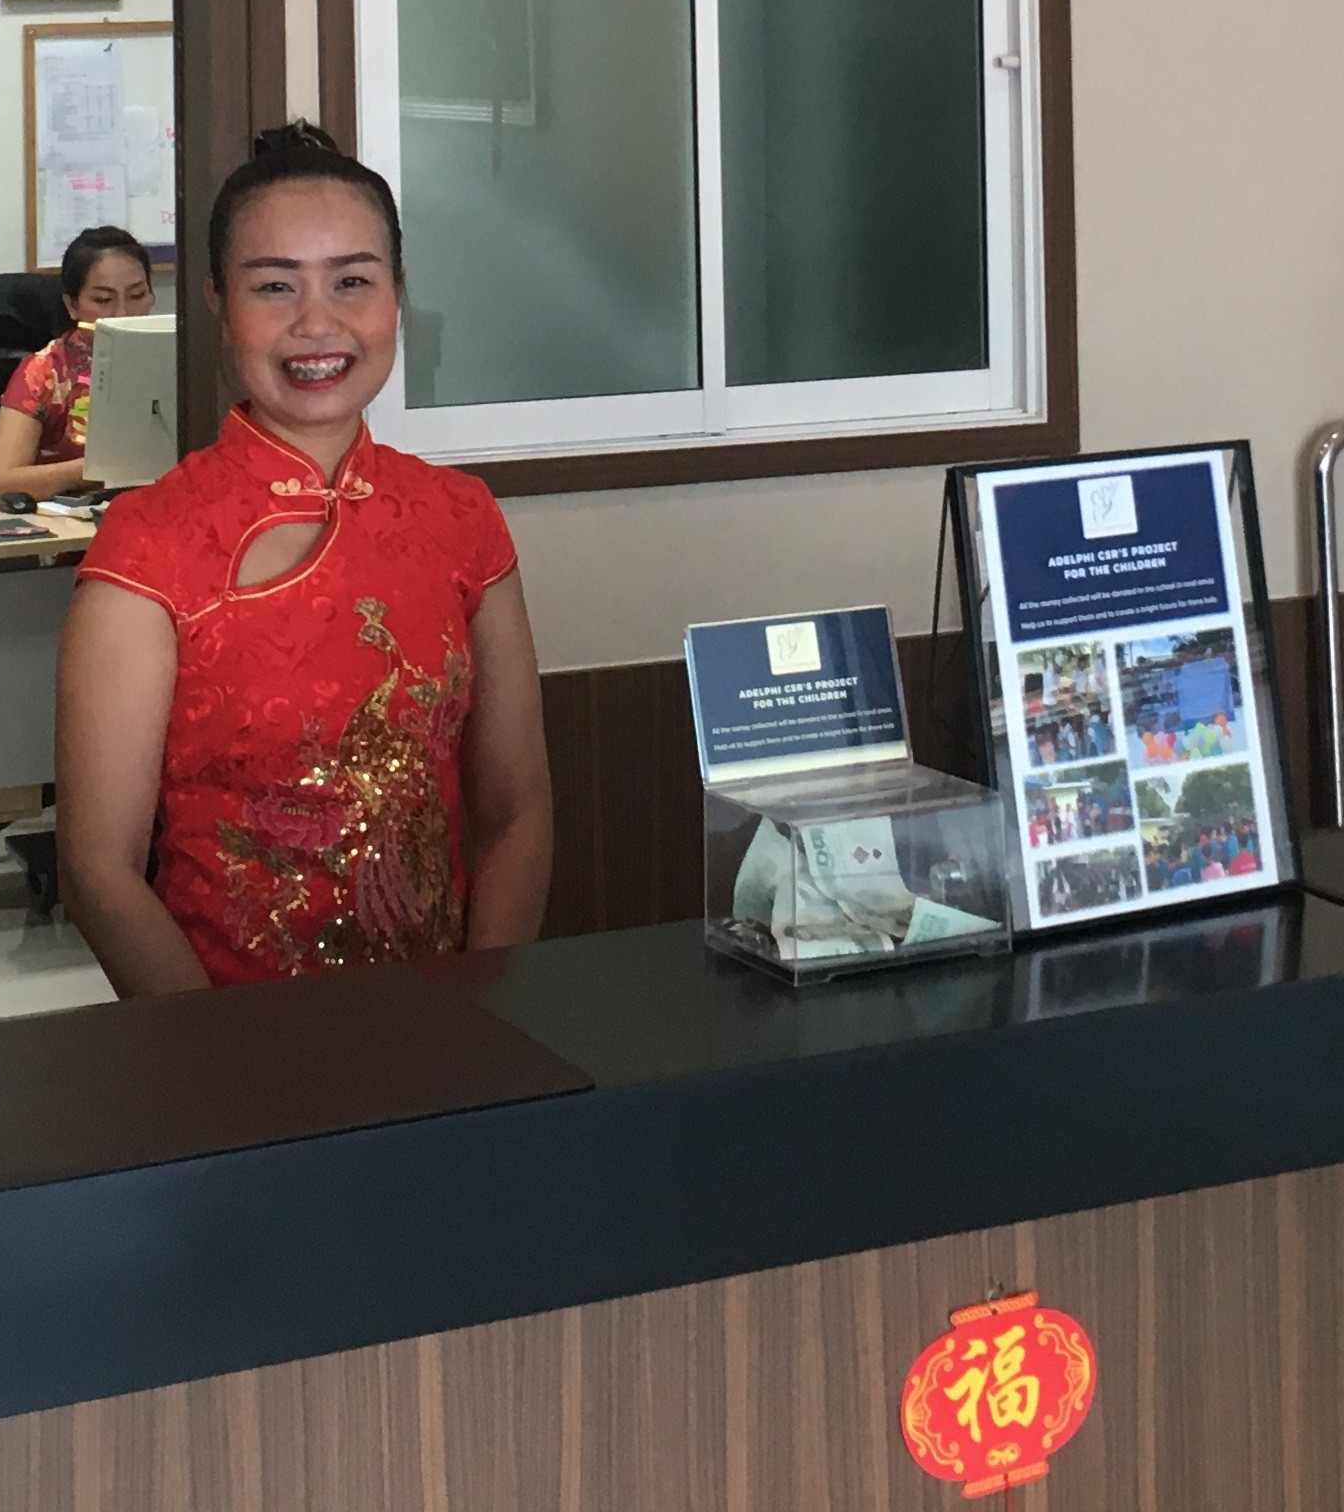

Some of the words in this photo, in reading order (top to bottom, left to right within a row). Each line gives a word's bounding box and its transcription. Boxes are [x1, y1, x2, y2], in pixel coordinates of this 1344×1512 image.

[1048, 552, 1095, 568] ADELPHI
[1097, 547, 1129, 562] CSR'S
[1131, 541, 1178, 558] PROJECT
[1063, 567, 1087, 580] FOR
[1089, 564, 1110, 577] THE
[1112, 557, 1167, 574] CHILDREN
[738, 685, 782, 700] ADELPHI
[784, 681, 813, 694] CSR'S
[814, 676, 859, 690] PROJECT
[752, 699, 774, 709] FOR
[776, 695, 796, 707] THE
[798, 690, 848, 704] CHILDREN
[944, 1325, 1039, 1443] 福
